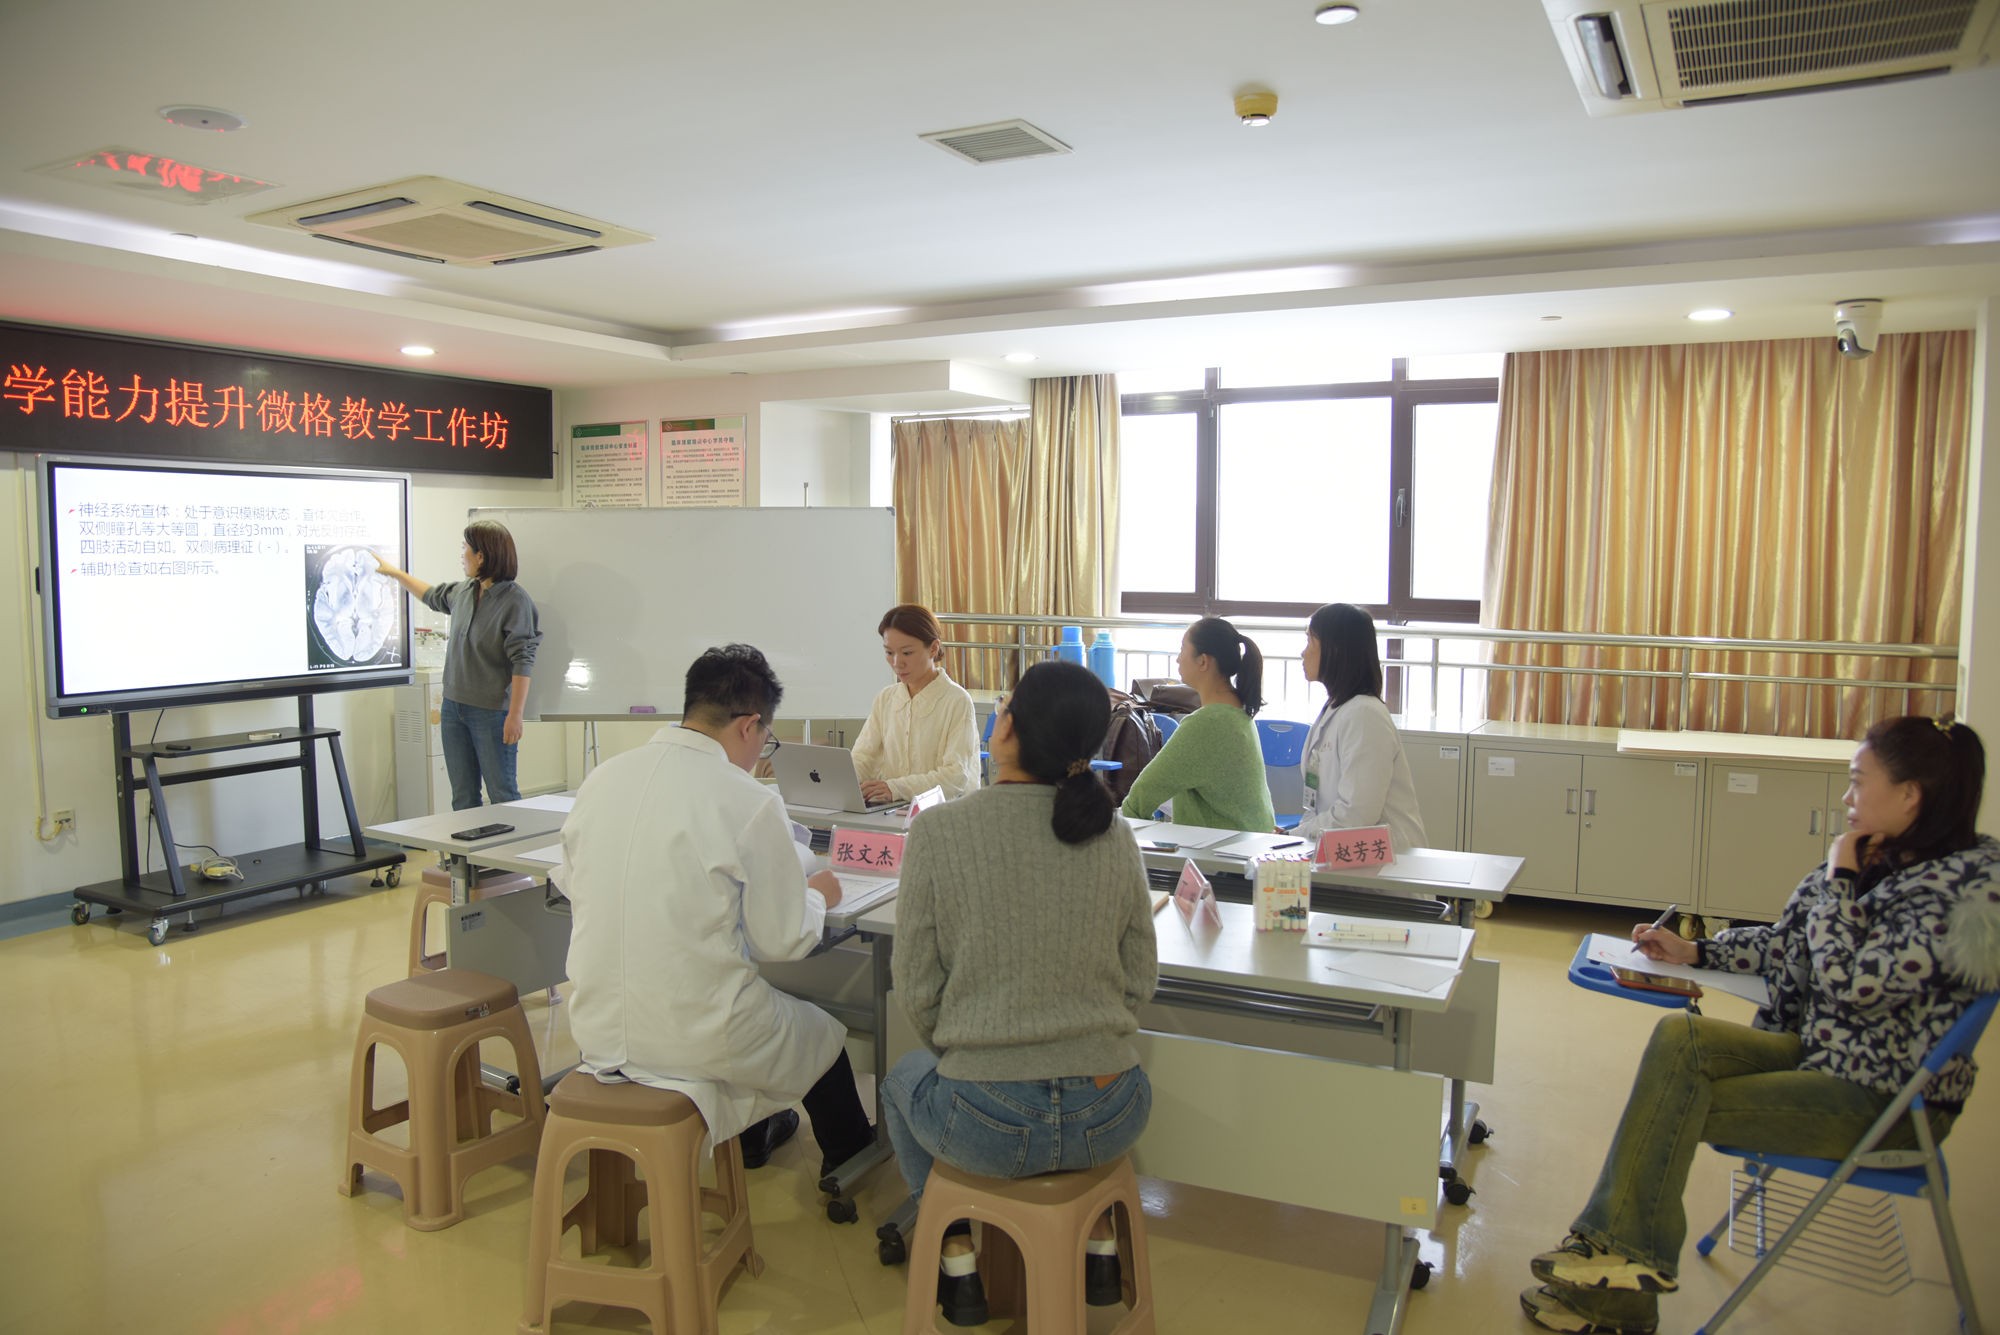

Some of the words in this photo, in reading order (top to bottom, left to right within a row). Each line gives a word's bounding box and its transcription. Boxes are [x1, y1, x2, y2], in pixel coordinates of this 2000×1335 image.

[3, 363, 509, 449] 学能力提升微格教学工作坊
[80, 560, 219, 576] 辅助检查如右图所示。
[837, 842, 895, 867] 张文杰
[1335, 838, 1387, 862] 赵芳芳
